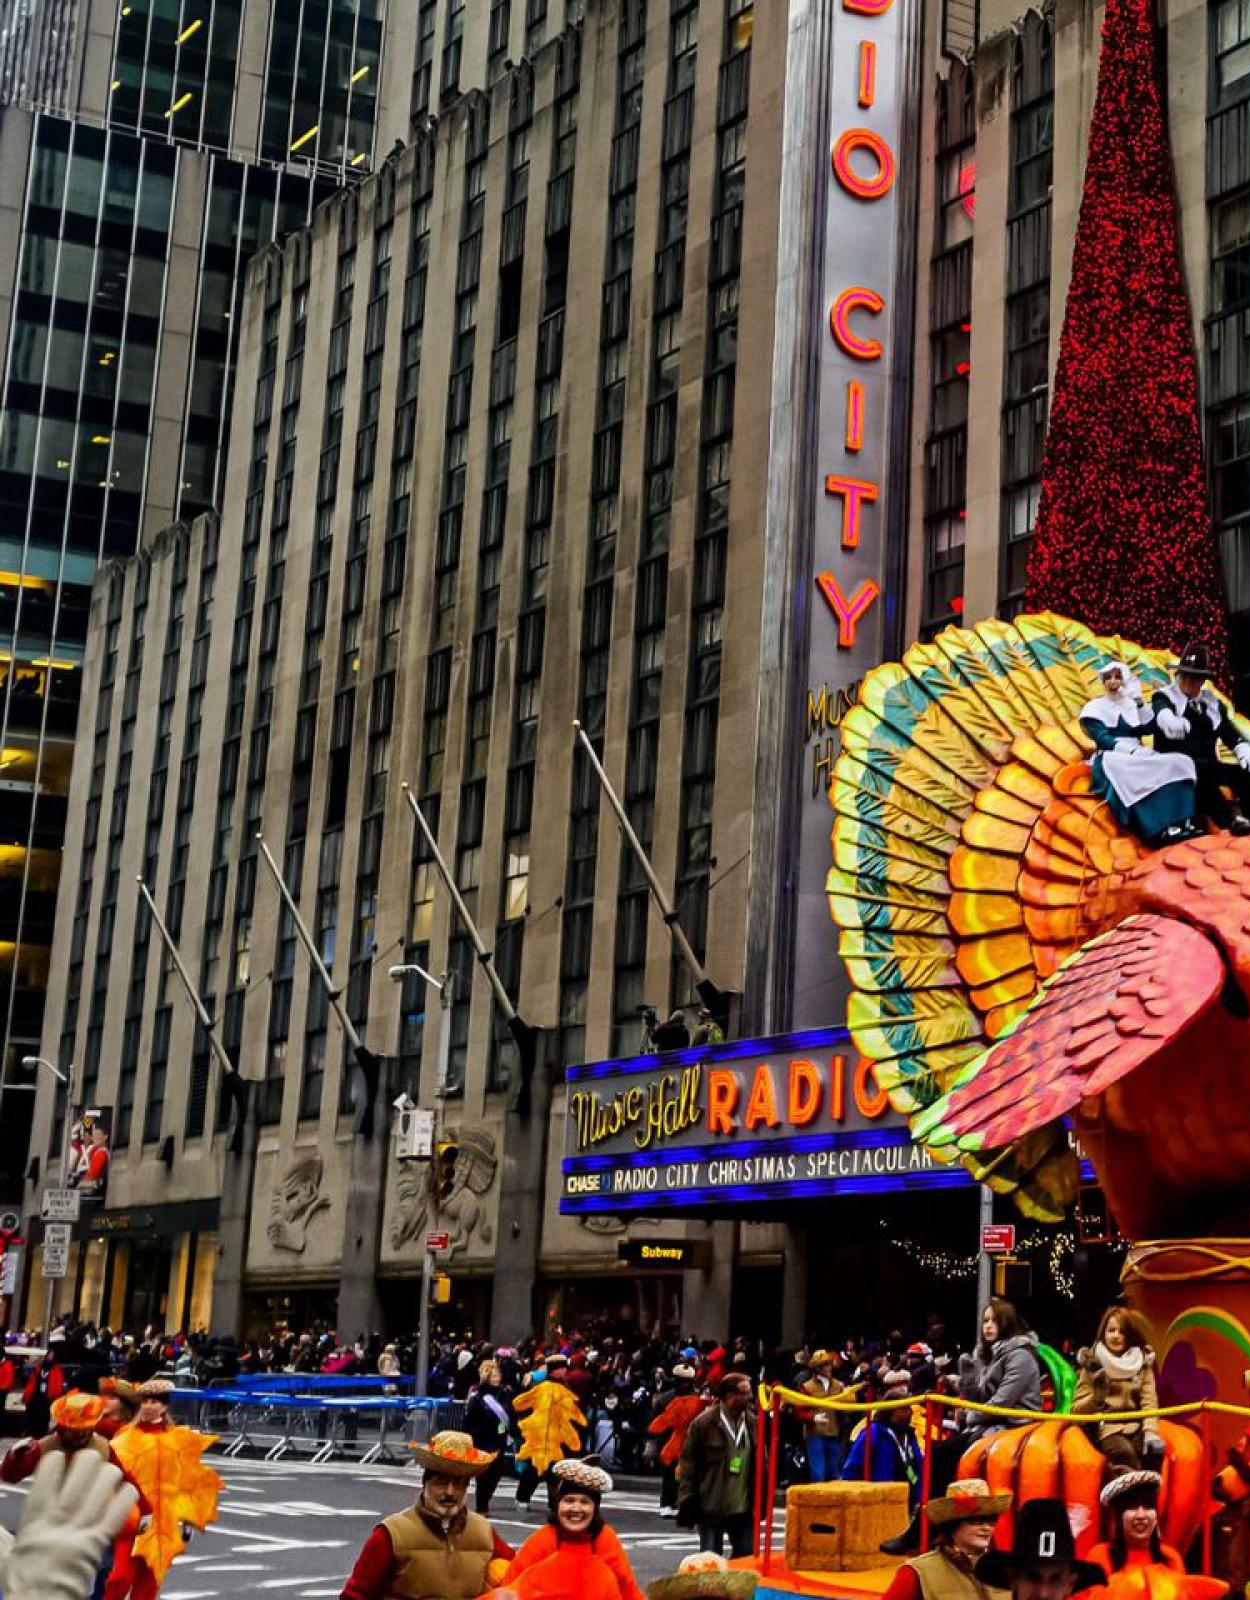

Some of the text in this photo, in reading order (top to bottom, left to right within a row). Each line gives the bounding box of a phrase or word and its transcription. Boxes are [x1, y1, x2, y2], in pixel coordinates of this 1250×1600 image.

[816, 0, 896, 649] IO CITY
[634, 1063, 702, 1149] Hall
[706, 1053, 890, 1136] RADIO
[567, 1174, 601, 1193] CHASE
[614, 1167, 657, 1192] RADIO
[666, 1163, 699, 1188] CITY
[708, 1155, 796, 1185] CHRISTMAS
[641, 1245, 683, 1261] Subway
